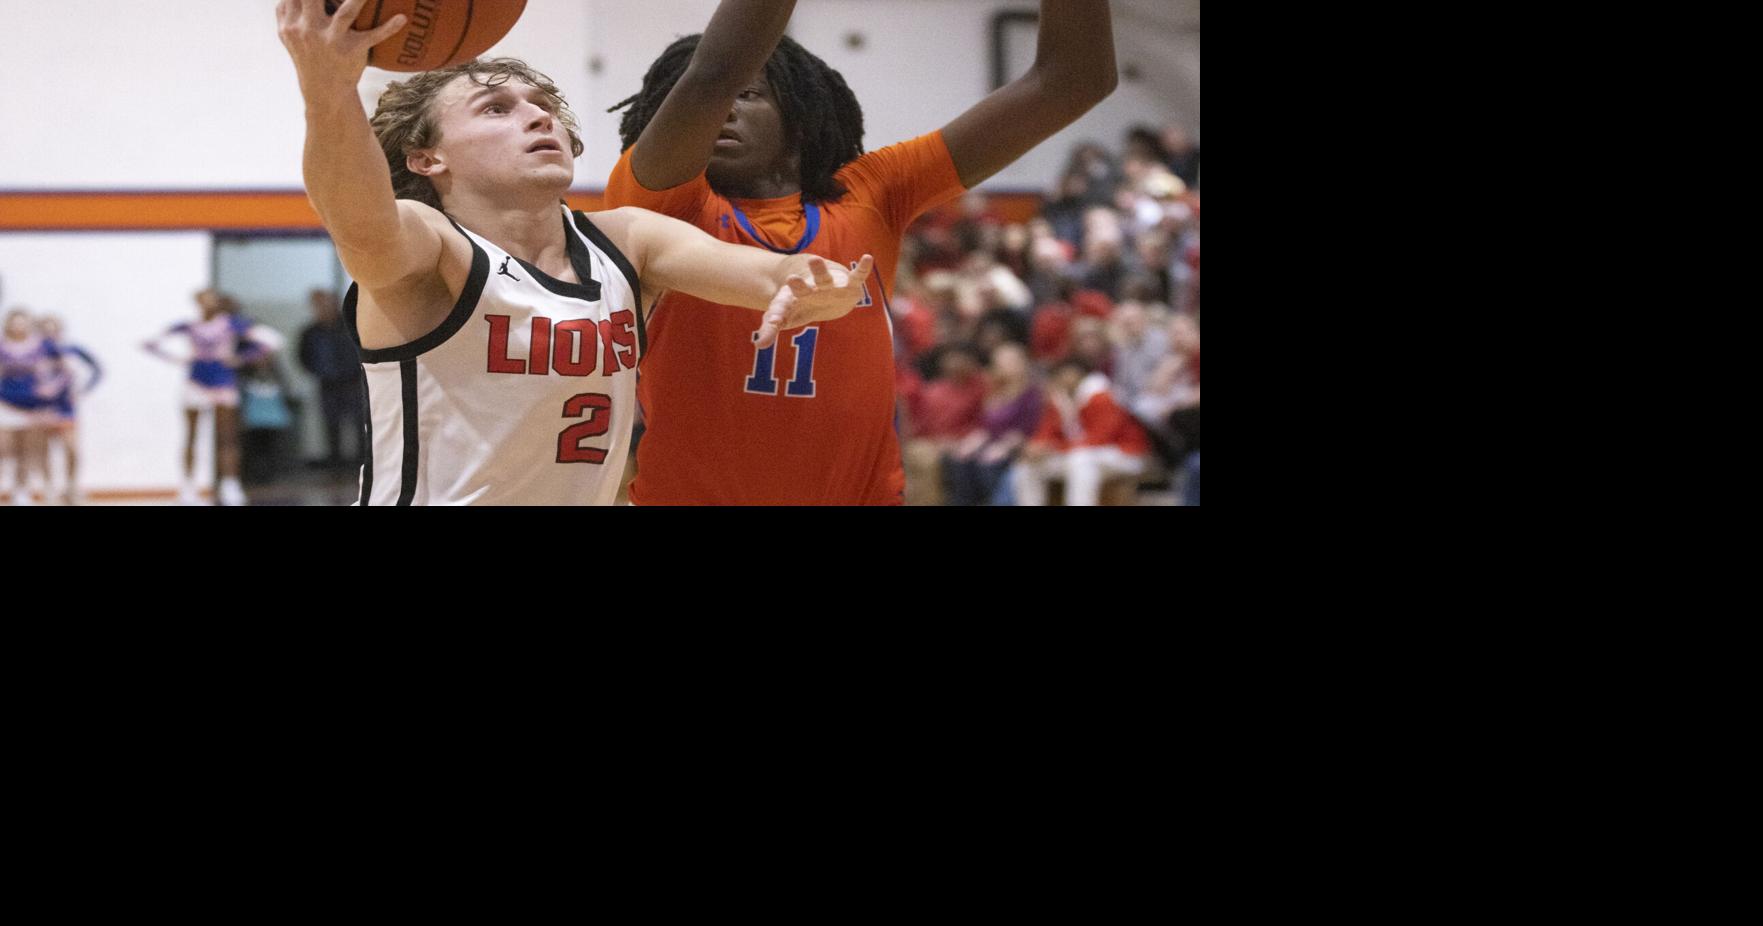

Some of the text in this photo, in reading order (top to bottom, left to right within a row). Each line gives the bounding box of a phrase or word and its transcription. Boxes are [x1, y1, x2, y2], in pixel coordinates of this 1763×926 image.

[396, 0, 437, 66] EVOLUT
[744, 326, 819, 398] 11
[555, 392, 612, 464] 2
